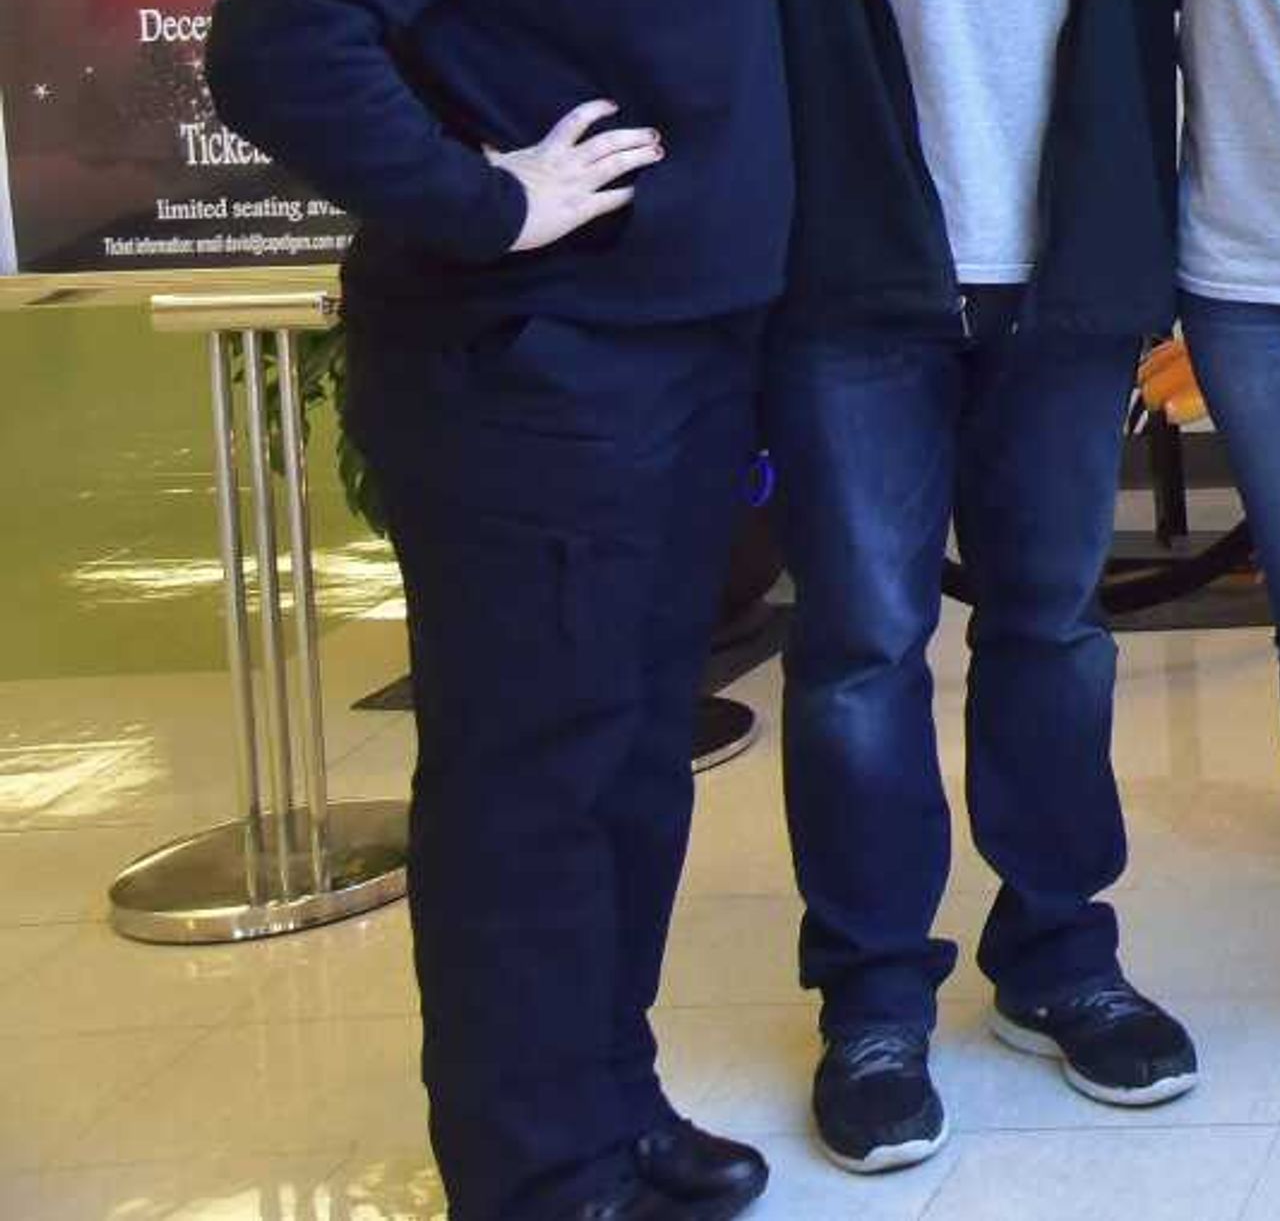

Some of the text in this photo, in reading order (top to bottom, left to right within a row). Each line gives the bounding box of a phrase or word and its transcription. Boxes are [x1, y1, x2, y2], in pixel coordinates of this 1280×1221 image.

[139, 9, 213, 42] Dece
[180, 122, 273, 165] Ticke
[156, 197, 228, 220] limited
[231, 196, 303, 221] seating
